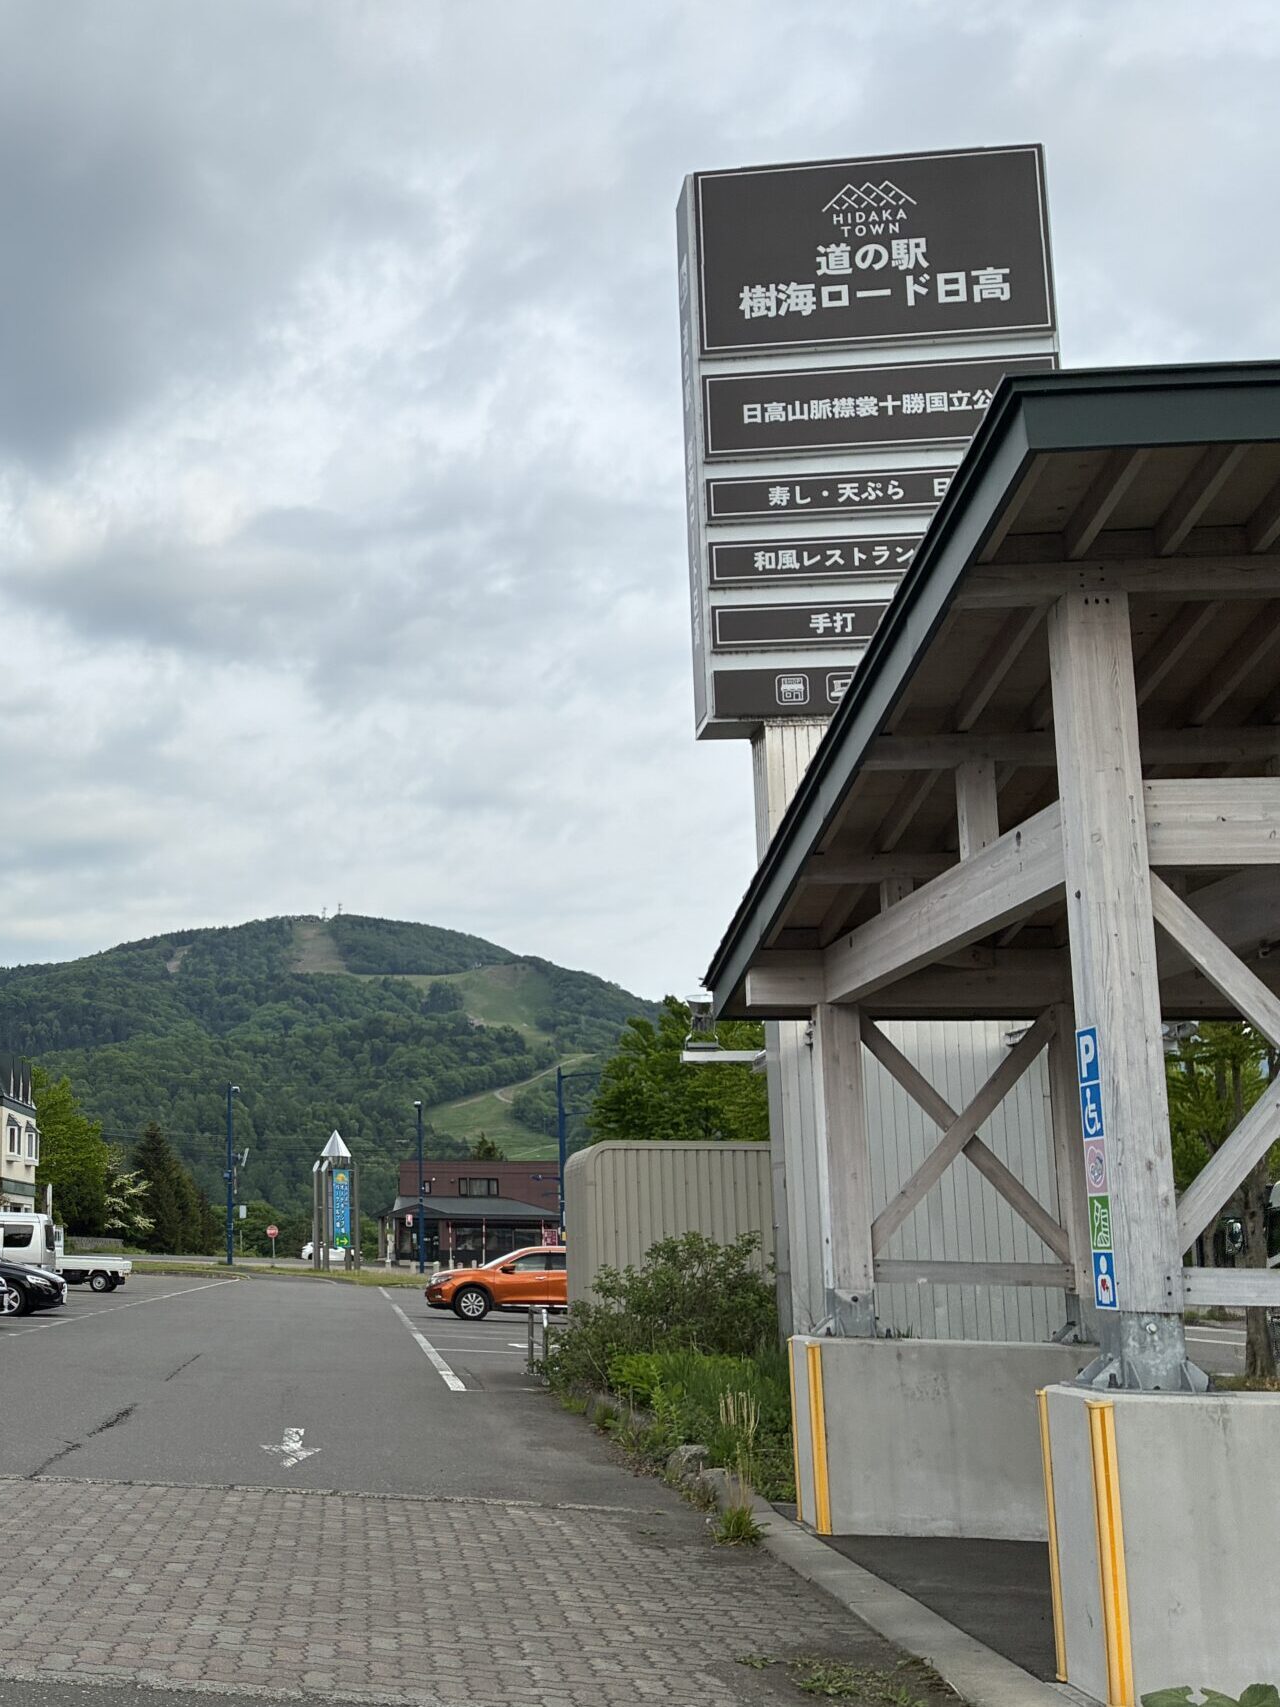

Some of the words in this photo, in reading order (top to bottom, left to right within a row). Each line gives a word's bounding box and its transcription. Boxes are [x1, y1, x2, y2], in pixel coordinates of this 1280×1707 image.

[832, 207, 908, 225] HIDAKA
[840, 222, 901, 237] TOWN
[815, 237, 930, 276] 道の駅
[738, 267, 1012, 320] 樹海ロード日高
[753, 545, 915, 571] 和風レストラン
[809, 612, 856, 634] 手打
[1080, 1035, 1095, 1078] P
